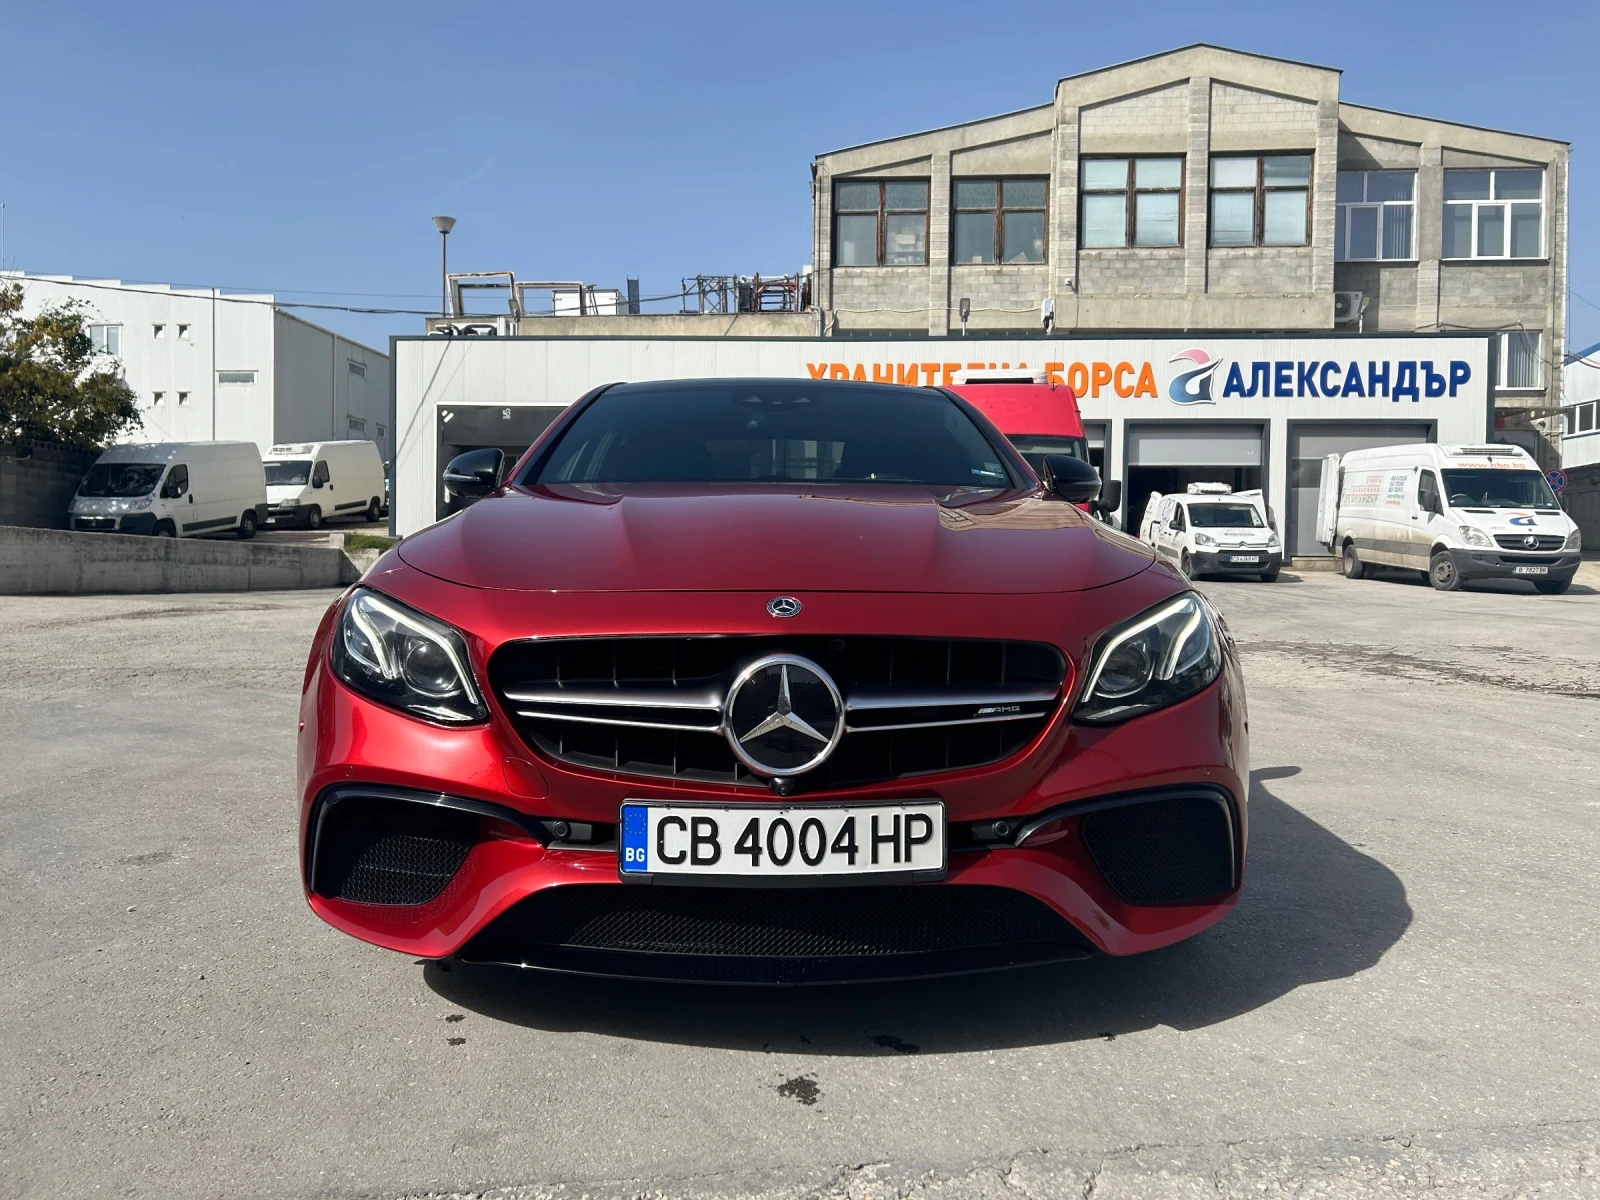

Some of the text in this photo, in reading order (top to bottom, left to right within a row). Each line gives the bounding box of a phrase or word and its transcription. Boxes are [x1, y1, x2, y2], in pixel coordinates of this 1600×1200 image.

[806, 361, 1471, 402] ХРАНИТЕ БОРСА АЛЕКСАНДЪР
[625, 847, 645, 863] BG
[657, 813, 933, 867] CB 4004 HP
